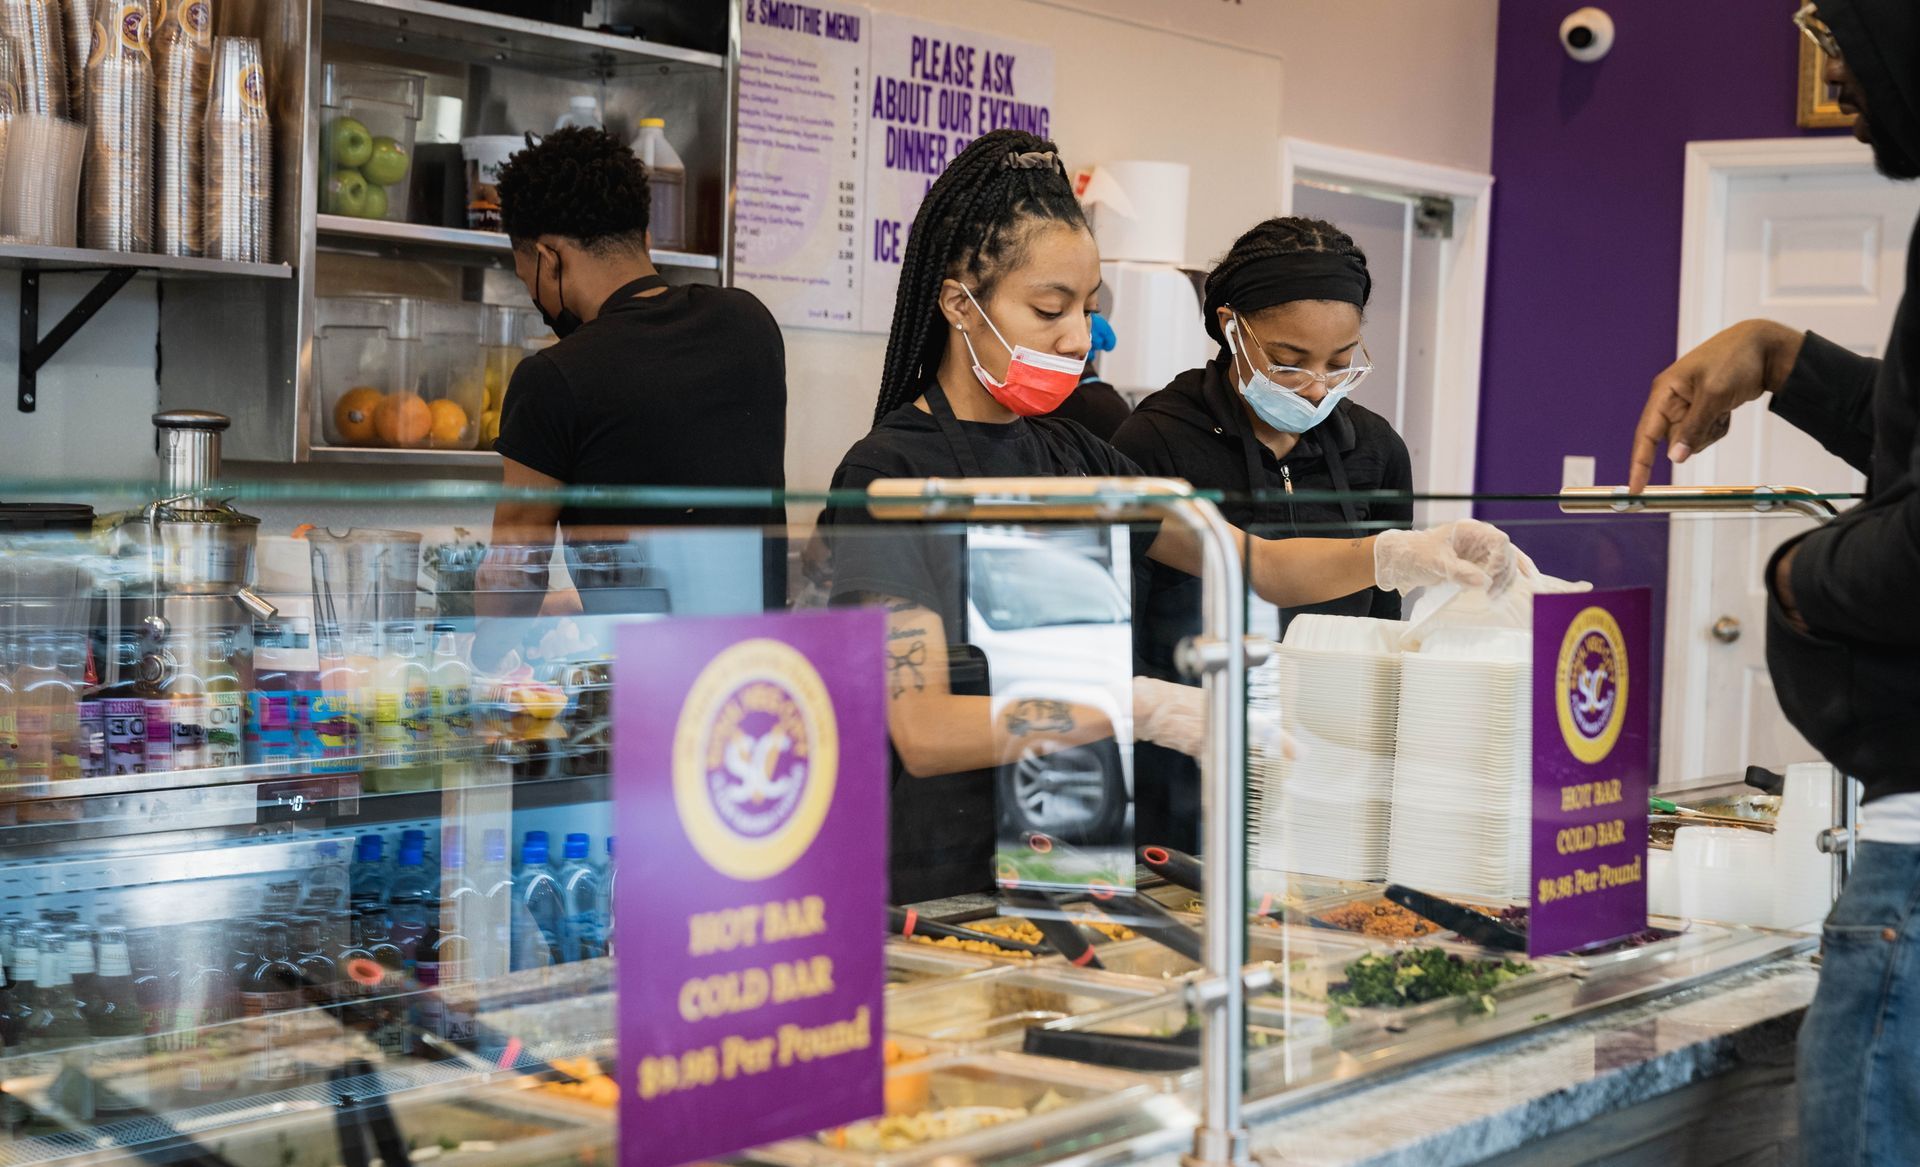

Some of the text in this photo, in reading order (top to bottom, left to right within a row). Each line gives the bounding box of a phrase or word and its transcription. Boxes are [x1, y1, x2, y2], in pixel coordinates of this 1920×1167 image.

[746, 0, 860, 43] & SMOOTHIE MENU
[911, 35, 1015, 96] PLEASE ASK
[872, 75, 932, 127] ABOUT
[938, 89, 972, 134] OUR
[978, 96, 1050, 141] EVENING
[886, 126, 947, 175] DINNER
[874, 219, 901, 263] ICE
[1561, 778, 1623, 812] HOT BAR
[1556, 819, 1626, 855] COLD BAR
[1574, 868, 1599, 895] Per
[1598, 854, 1641, 889] Pound
[688, 903, 762, 957] HOT
[677, 966, 770, 1023] COLD
[777, 1004, 872, 1068] Pound
